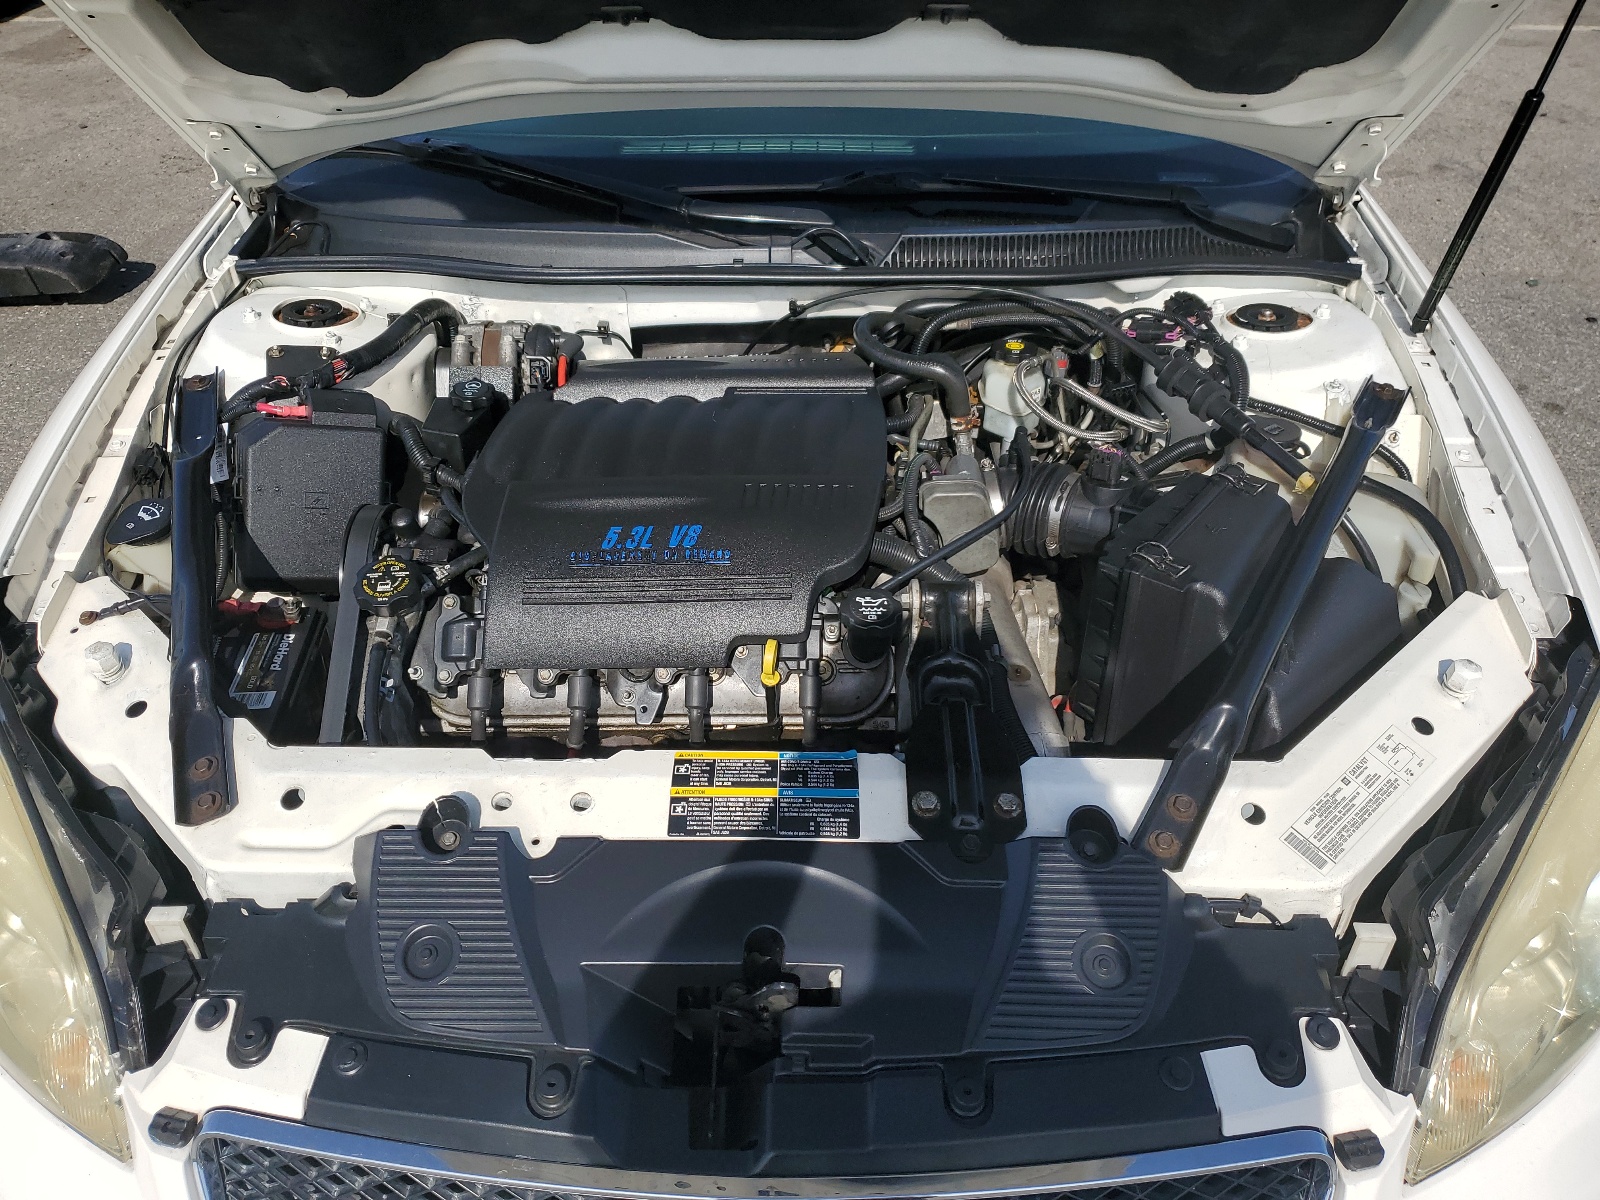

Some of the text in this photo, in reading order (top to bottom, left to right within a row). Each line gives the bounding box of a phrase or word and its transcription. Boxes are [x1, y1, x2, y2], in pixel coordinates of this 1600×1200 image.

[601, 525, 703, 549] 5.3L V8
[270, 634, 295, 670] DieHard
[1348, 756, 1370, 777] CATALYST
